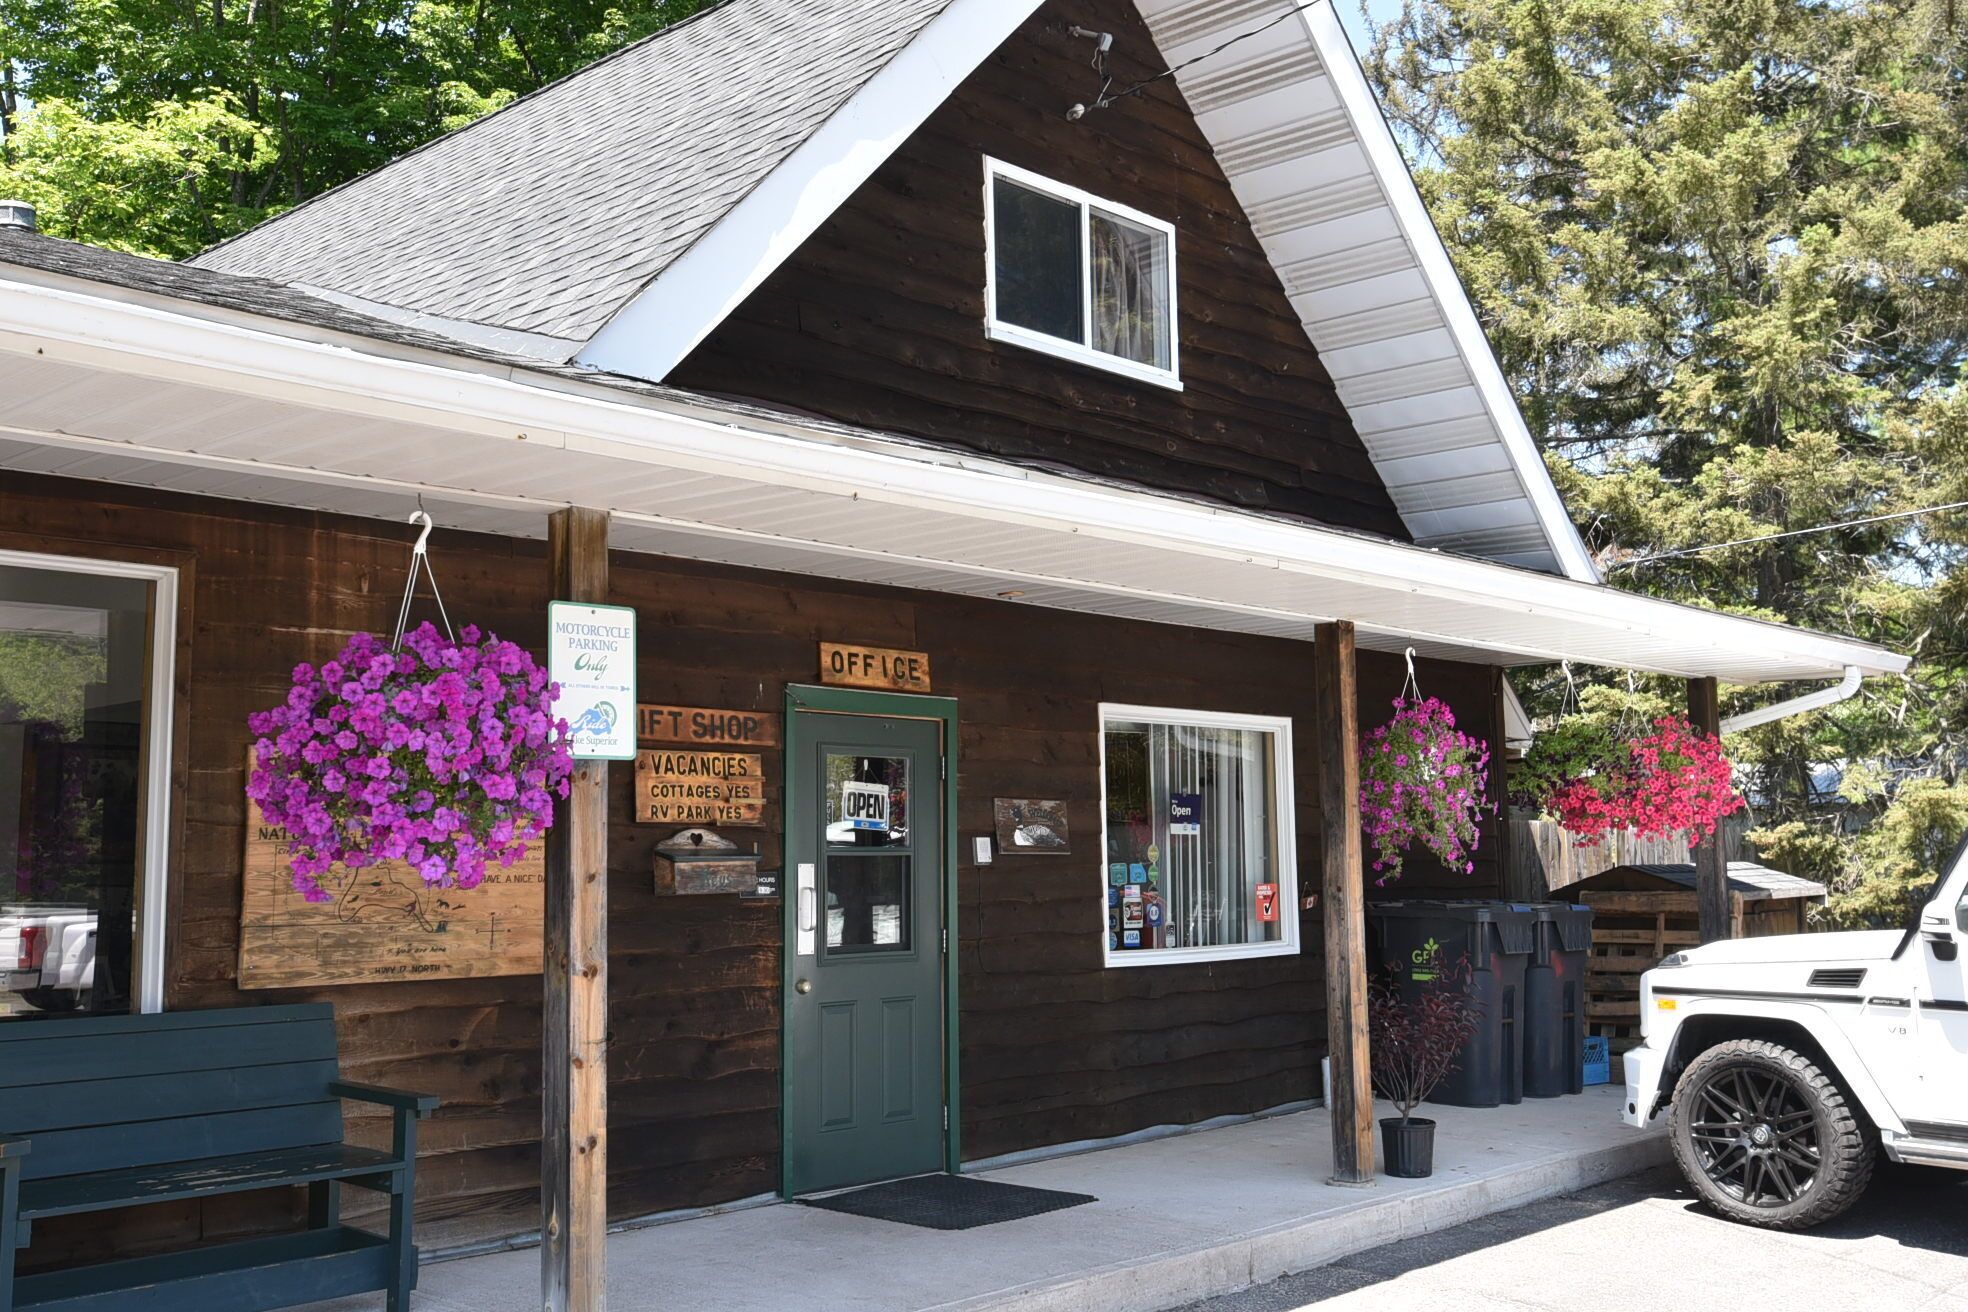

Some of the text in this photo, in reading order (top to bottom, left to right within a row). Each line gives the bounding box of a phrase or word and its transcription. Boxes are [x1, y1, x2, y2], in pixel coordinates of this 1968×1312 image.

[556, 622, 631, 639] MOTORCYCLE
[568, 637, 618, 652] PARKING
[574, 652, 609, 681] Only
[831, 650, 921, 681] OFFICE
[639, 709, 759, 741] IFT SHOP
[586, 736, 619, 747] Superior
[651, 754, 748, 777] VACANCIES
[651, 784, 750, 799] COTTAGES YES
[651, 805, 742, 820] RV PARK YES
[847, 791, 885, 820] OPEN
[1171, 804, 1192, 818] Open
[514, 874, 532, 883] NICE
[1125, 932, 1139, 941] VISA
[375, 966, 395, 974] HWY
[412, 964, 440, 973] NORTH
